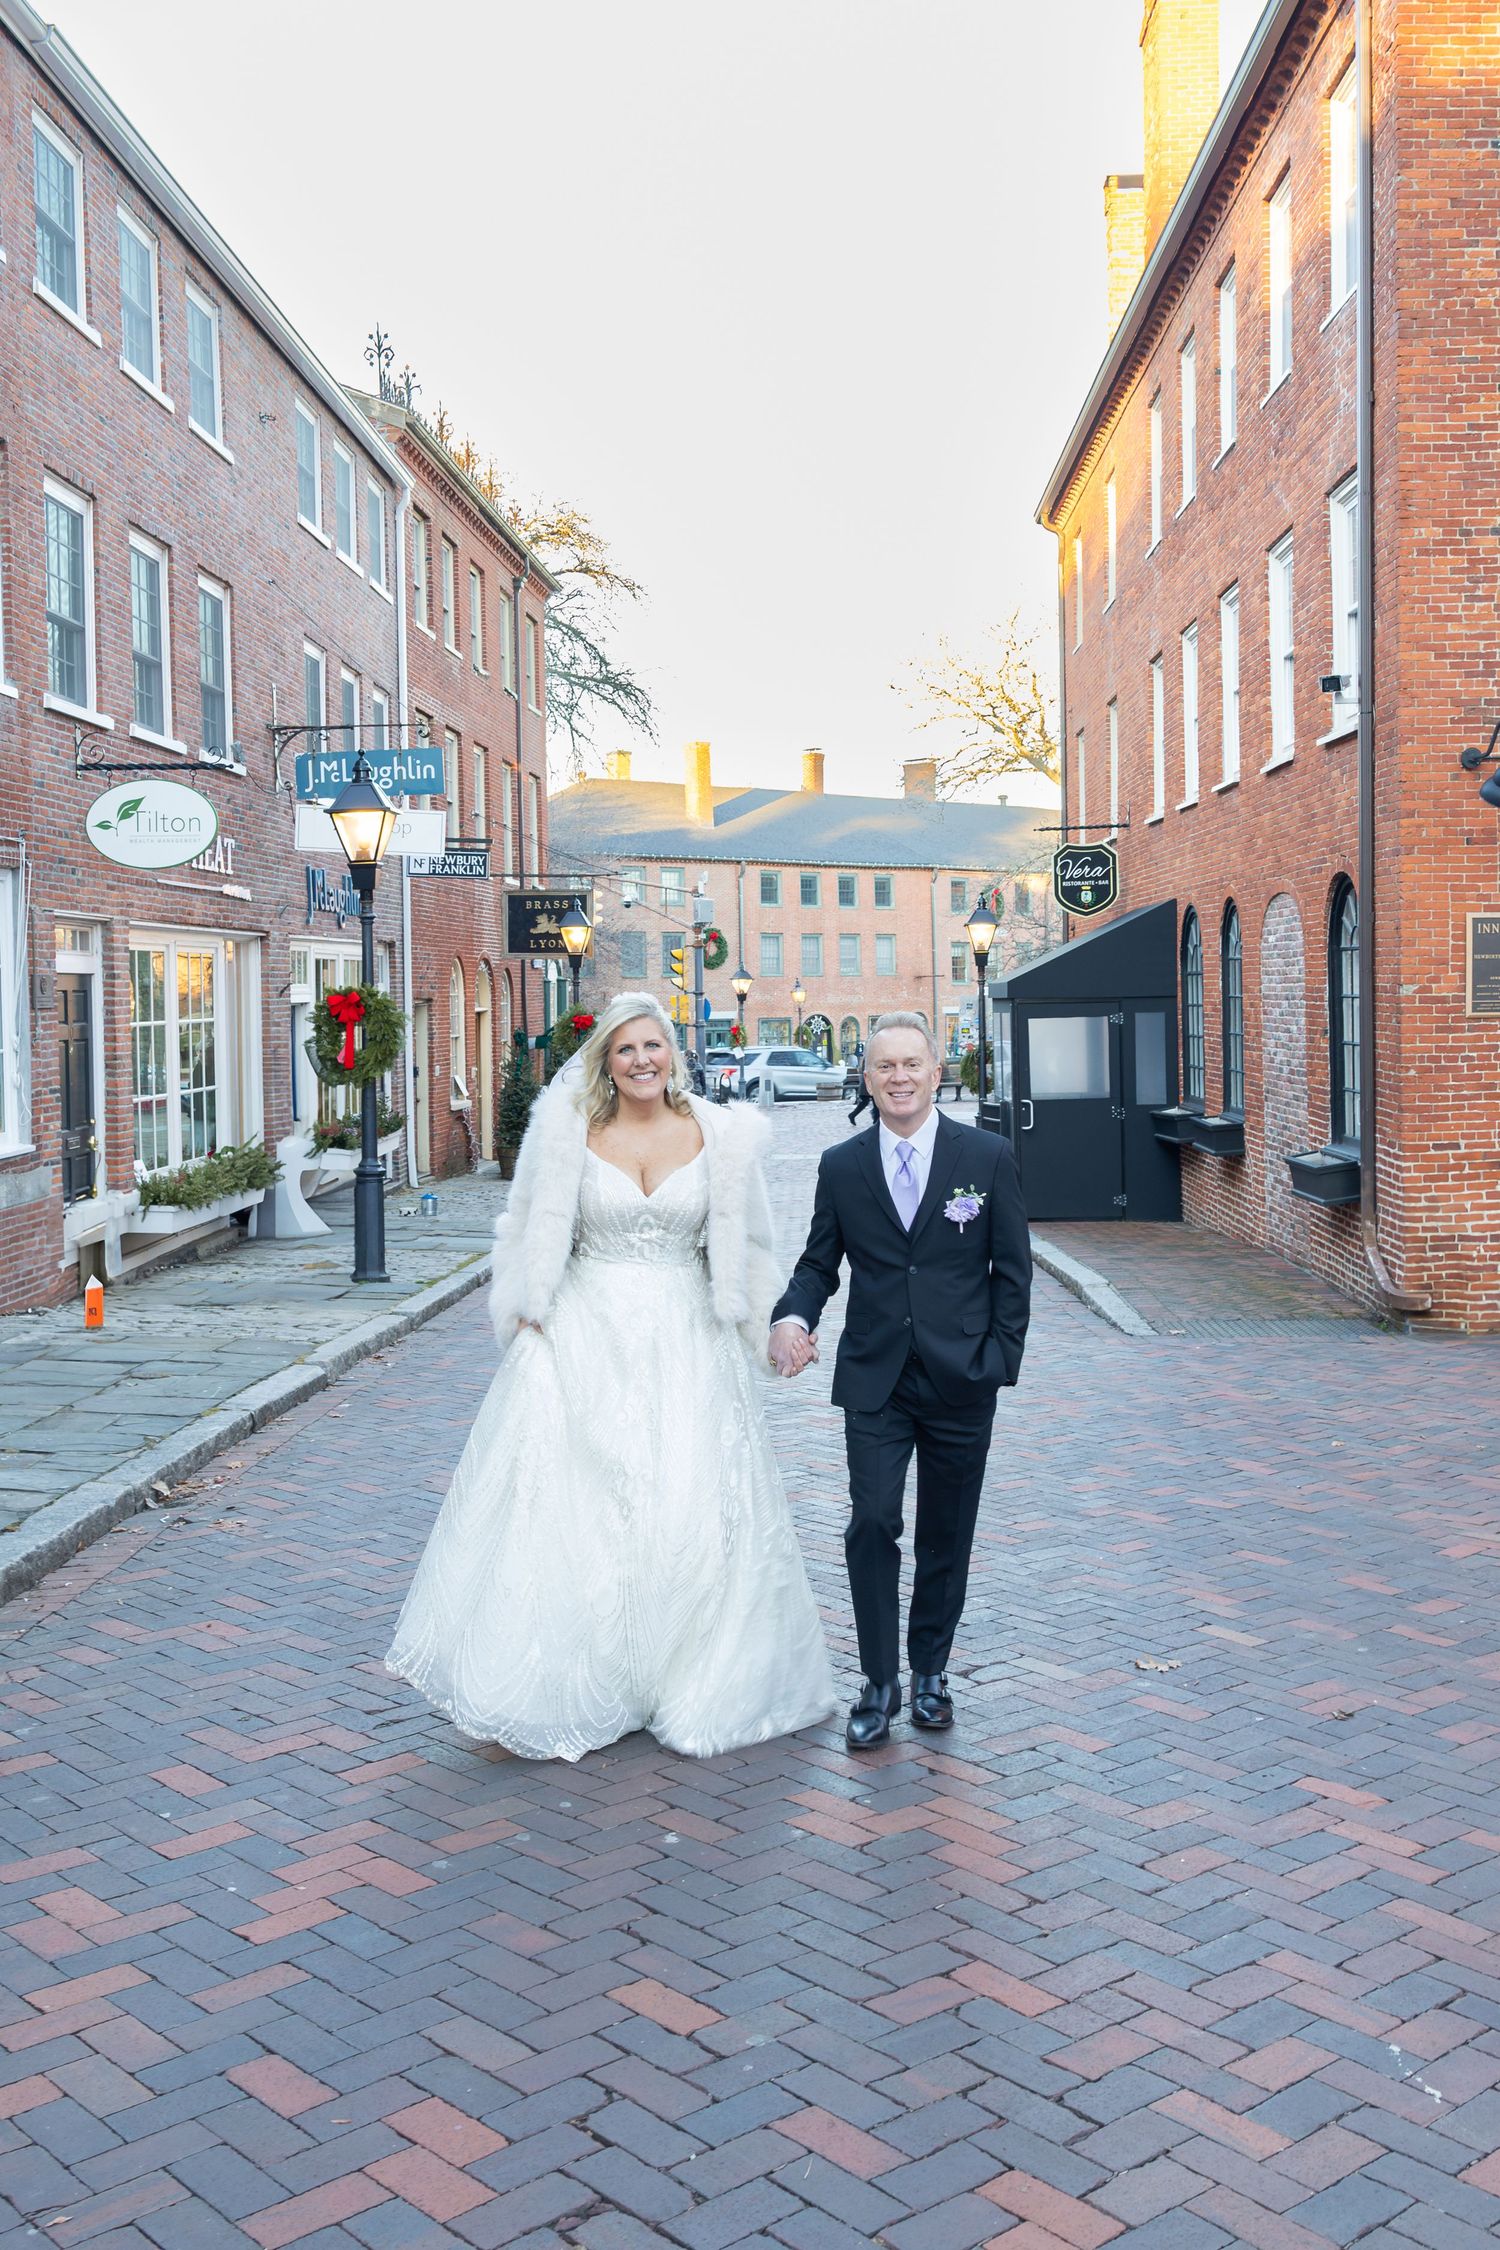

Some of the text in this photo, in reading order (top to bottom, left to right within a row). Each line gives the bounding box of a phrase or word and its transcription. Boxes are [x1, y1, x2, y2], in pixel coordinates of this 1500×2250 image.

[304, 756, 436, 793] J.McLughlin
[128, 810, 201, 833] Tilton
[430, 855, 486, 866] NEWBURY
[429, 864, 485, 875] FRANKLIN
[1056, 856, 1114, 880] Vera
[525, 900, 569, 910] BRASS
[530, 939, 566, 949] LYON
